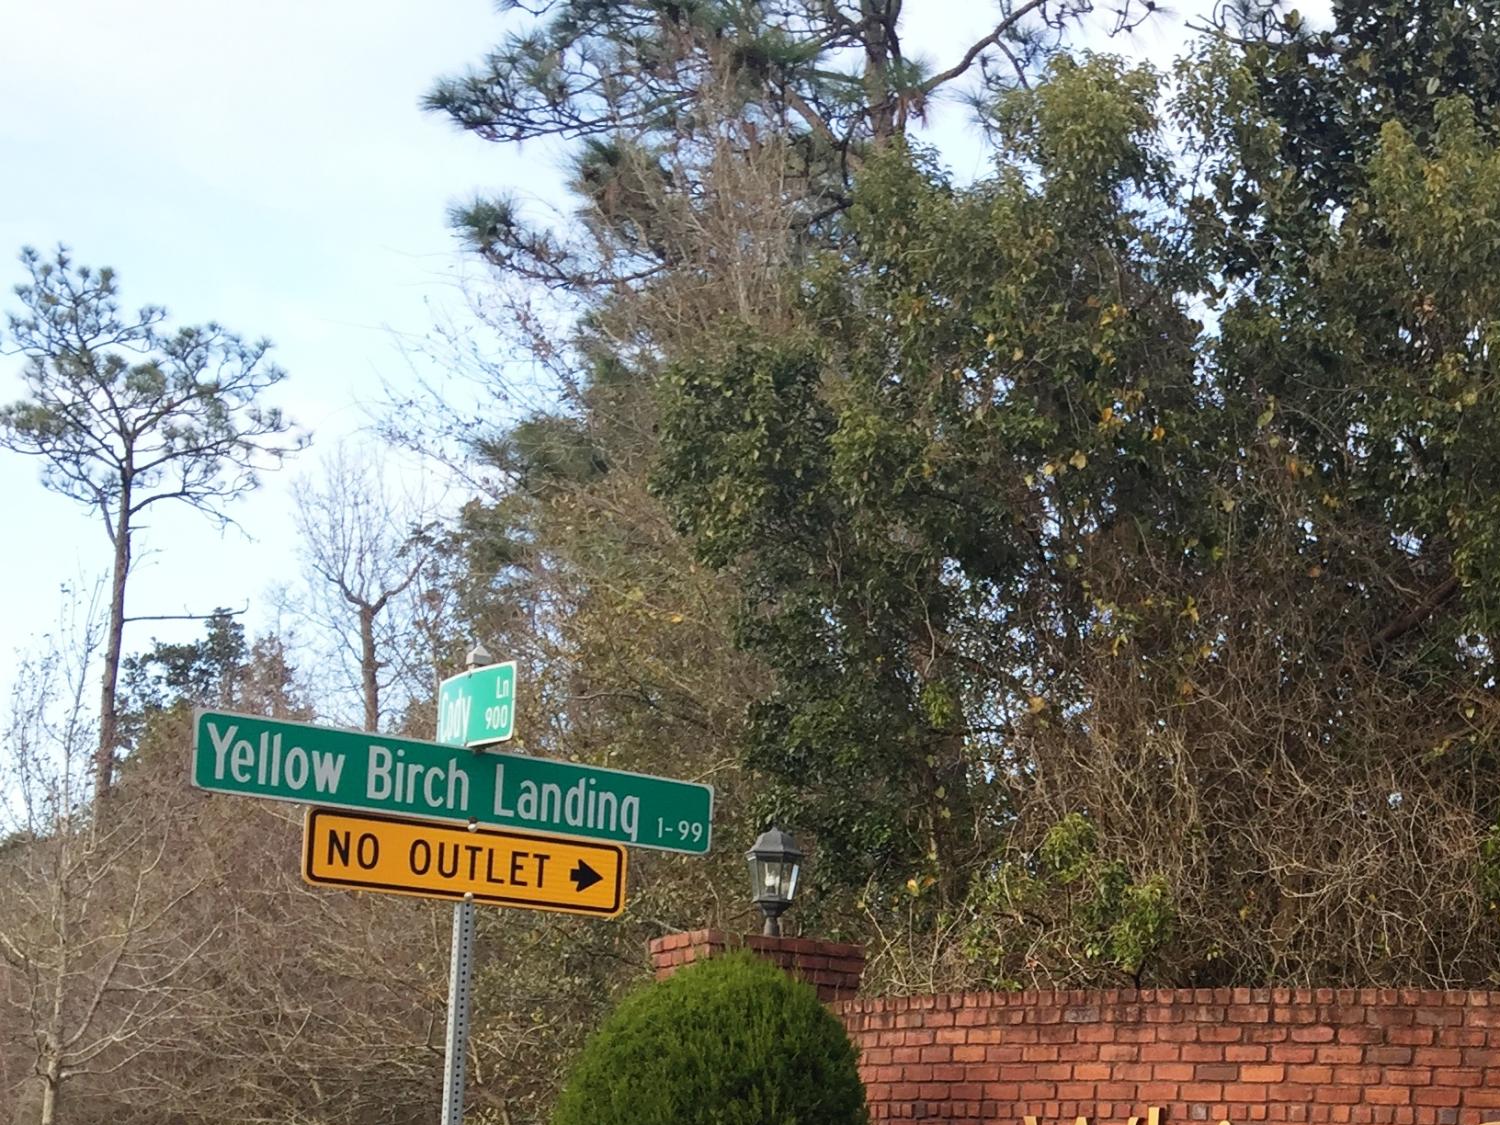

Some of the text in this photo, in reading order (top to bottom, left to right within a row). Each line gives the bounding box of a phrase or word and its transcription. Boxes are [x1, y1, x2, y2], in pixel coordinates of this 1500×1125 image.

[496, 676, 509, 698] Ln
[485, 704, 509, 730] 900
[206, 722, 703, 843] Yellow Birch Landing 1-99
[327, 830, 551, 889] NO OUTLET
